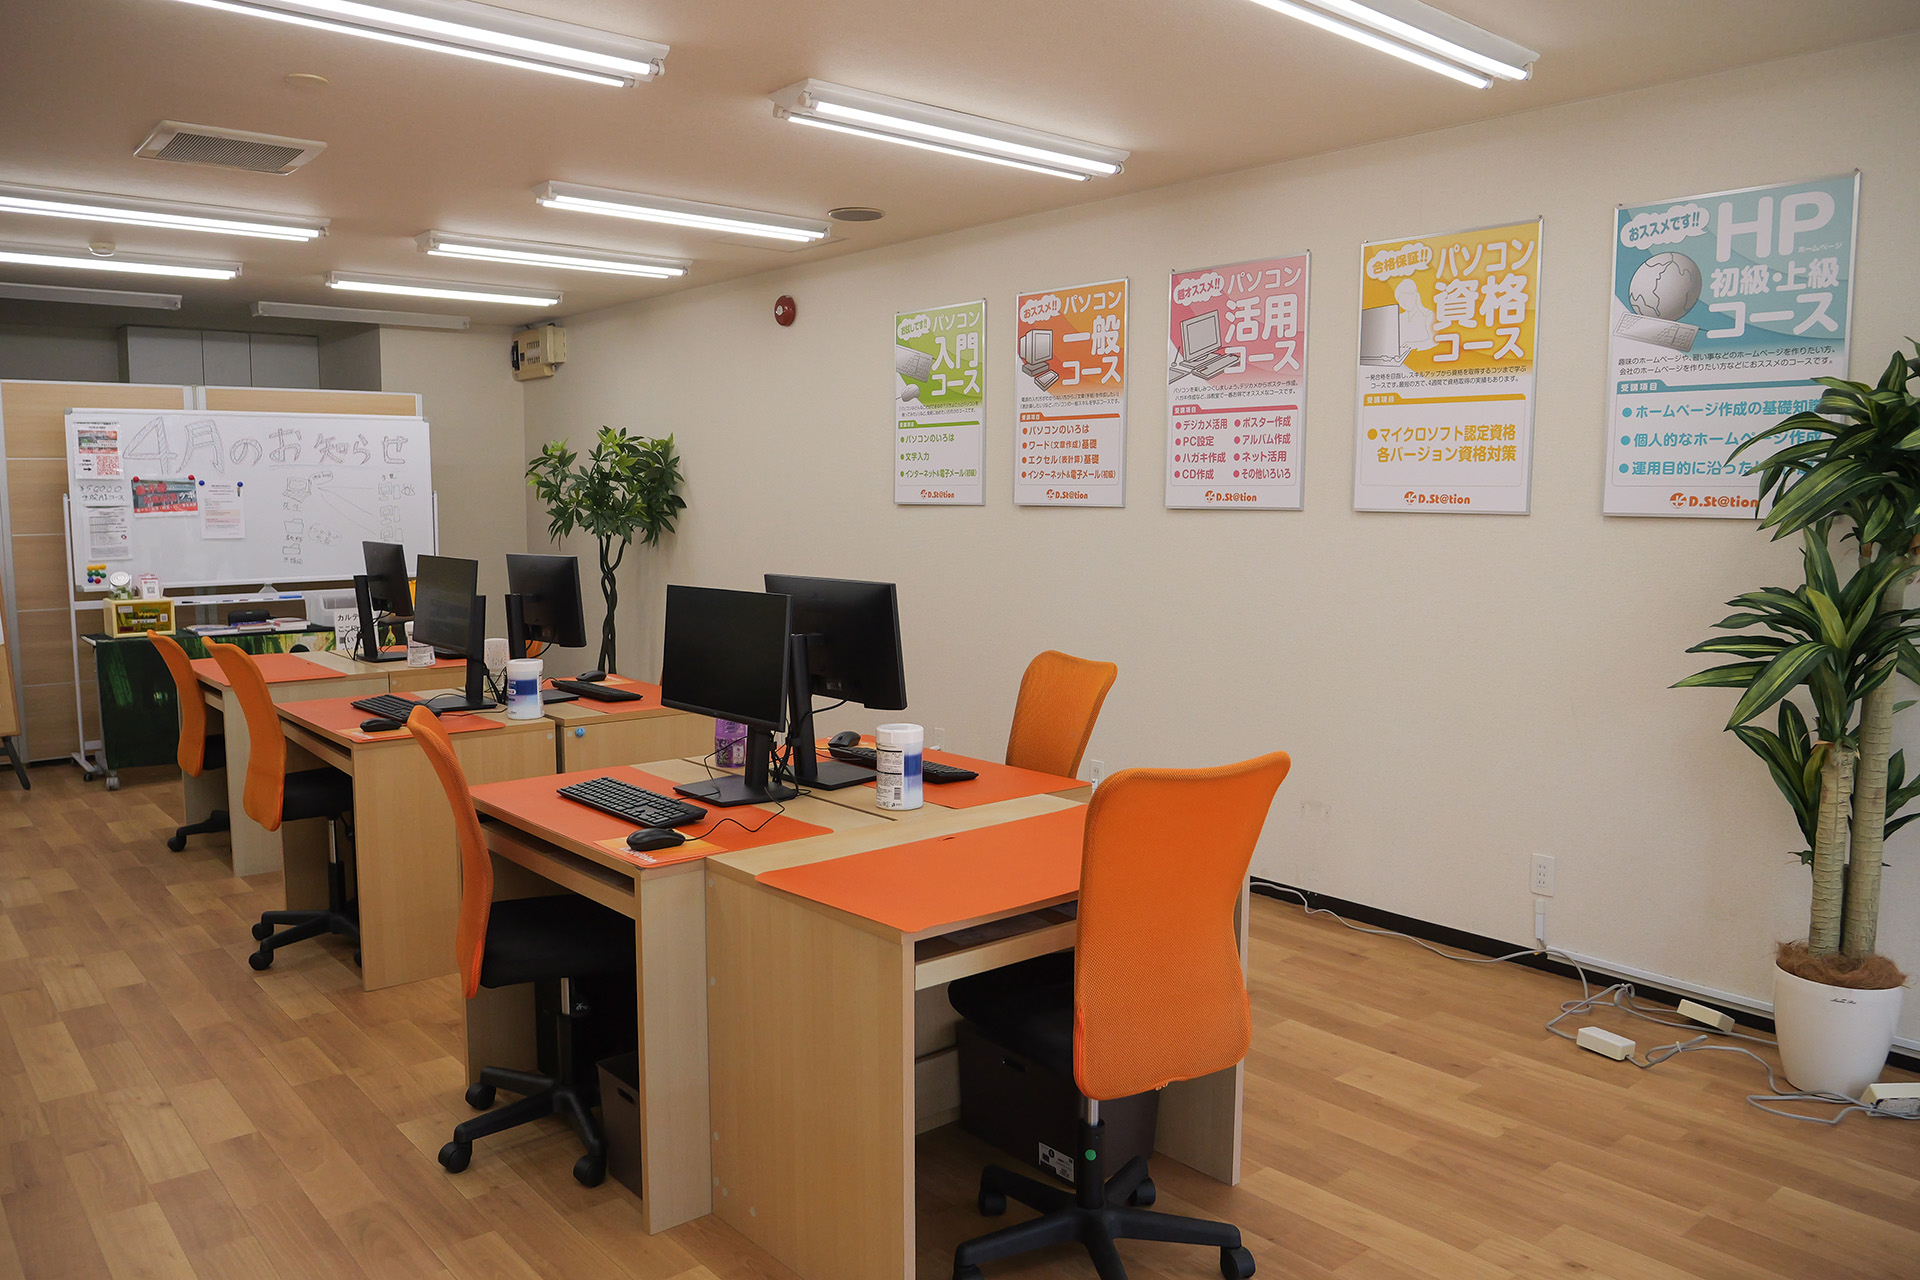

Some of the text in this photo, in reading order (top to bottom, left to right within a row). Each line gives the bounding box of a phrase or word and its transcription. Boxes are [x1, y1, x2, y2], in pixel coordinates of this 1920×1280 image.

[1716, 191, 1836, 263] HP
[1798, 241, 1843, 253] ホームページ
[1436, 239, 1535, 279] パソコン
[1227, 266, 1302, 295] パソコン
[1710, 257, 1840, 298] 初級・上級
[1063, 291, 1122, 314] パソコン
[1433, 272, 1529, 331] 資格
[932, 312, 980, 332] パソコン
[1224, 293, 1298, 343] 活用
[1706, 291, 1839, 339] コース
[1062, 314, 1121, 356] 一般
[931, 332, 979, 371] 入門
[1433, 327, 1525, 363] コース
[1223, 340, 1300, 374] コース
[1062, 355, 1122, 386] コース
[931, 369, 980, 396] コース
[1620, 382, 1658, 392] 受講項目
[1028, 424, 1090, 435] パソコンのいろは
[1183, 418, 1228, 431] デジカメ活用
[1242, 416, 1292, 428] ポスター作成
[905, 433, 955, 444] パソコンのいろは
[1242, 433, 1291, 446] アルバム作成
[1379, 424, 1516, 442] マイクロソフト認定資格
[122, 415, 409, 476] 4月のお知らせ
[1182, 436, 1214, 447] PC設定
[905, 452, 930, 461] 文字入力
[1182, 452, 1226, 463] ハガキ作成
[1241, 450, 1287, 462] ネット活用
[1377, 445, 1517, 463] 各バージョン資格対策
[1182, 469, 1214, 480] CD作成
[1241, 468, 1291, 480] その他いろいろ
[927, 490, 955, 499] D.St@tion
[1055, 490, 1088, 499] D.St@tion
[1216, 492, 1257, 502] D.St@tion
[1418, 493, 1471, 504] D.St@tion
[1688, 494, 1760, 508] D.St@tion
